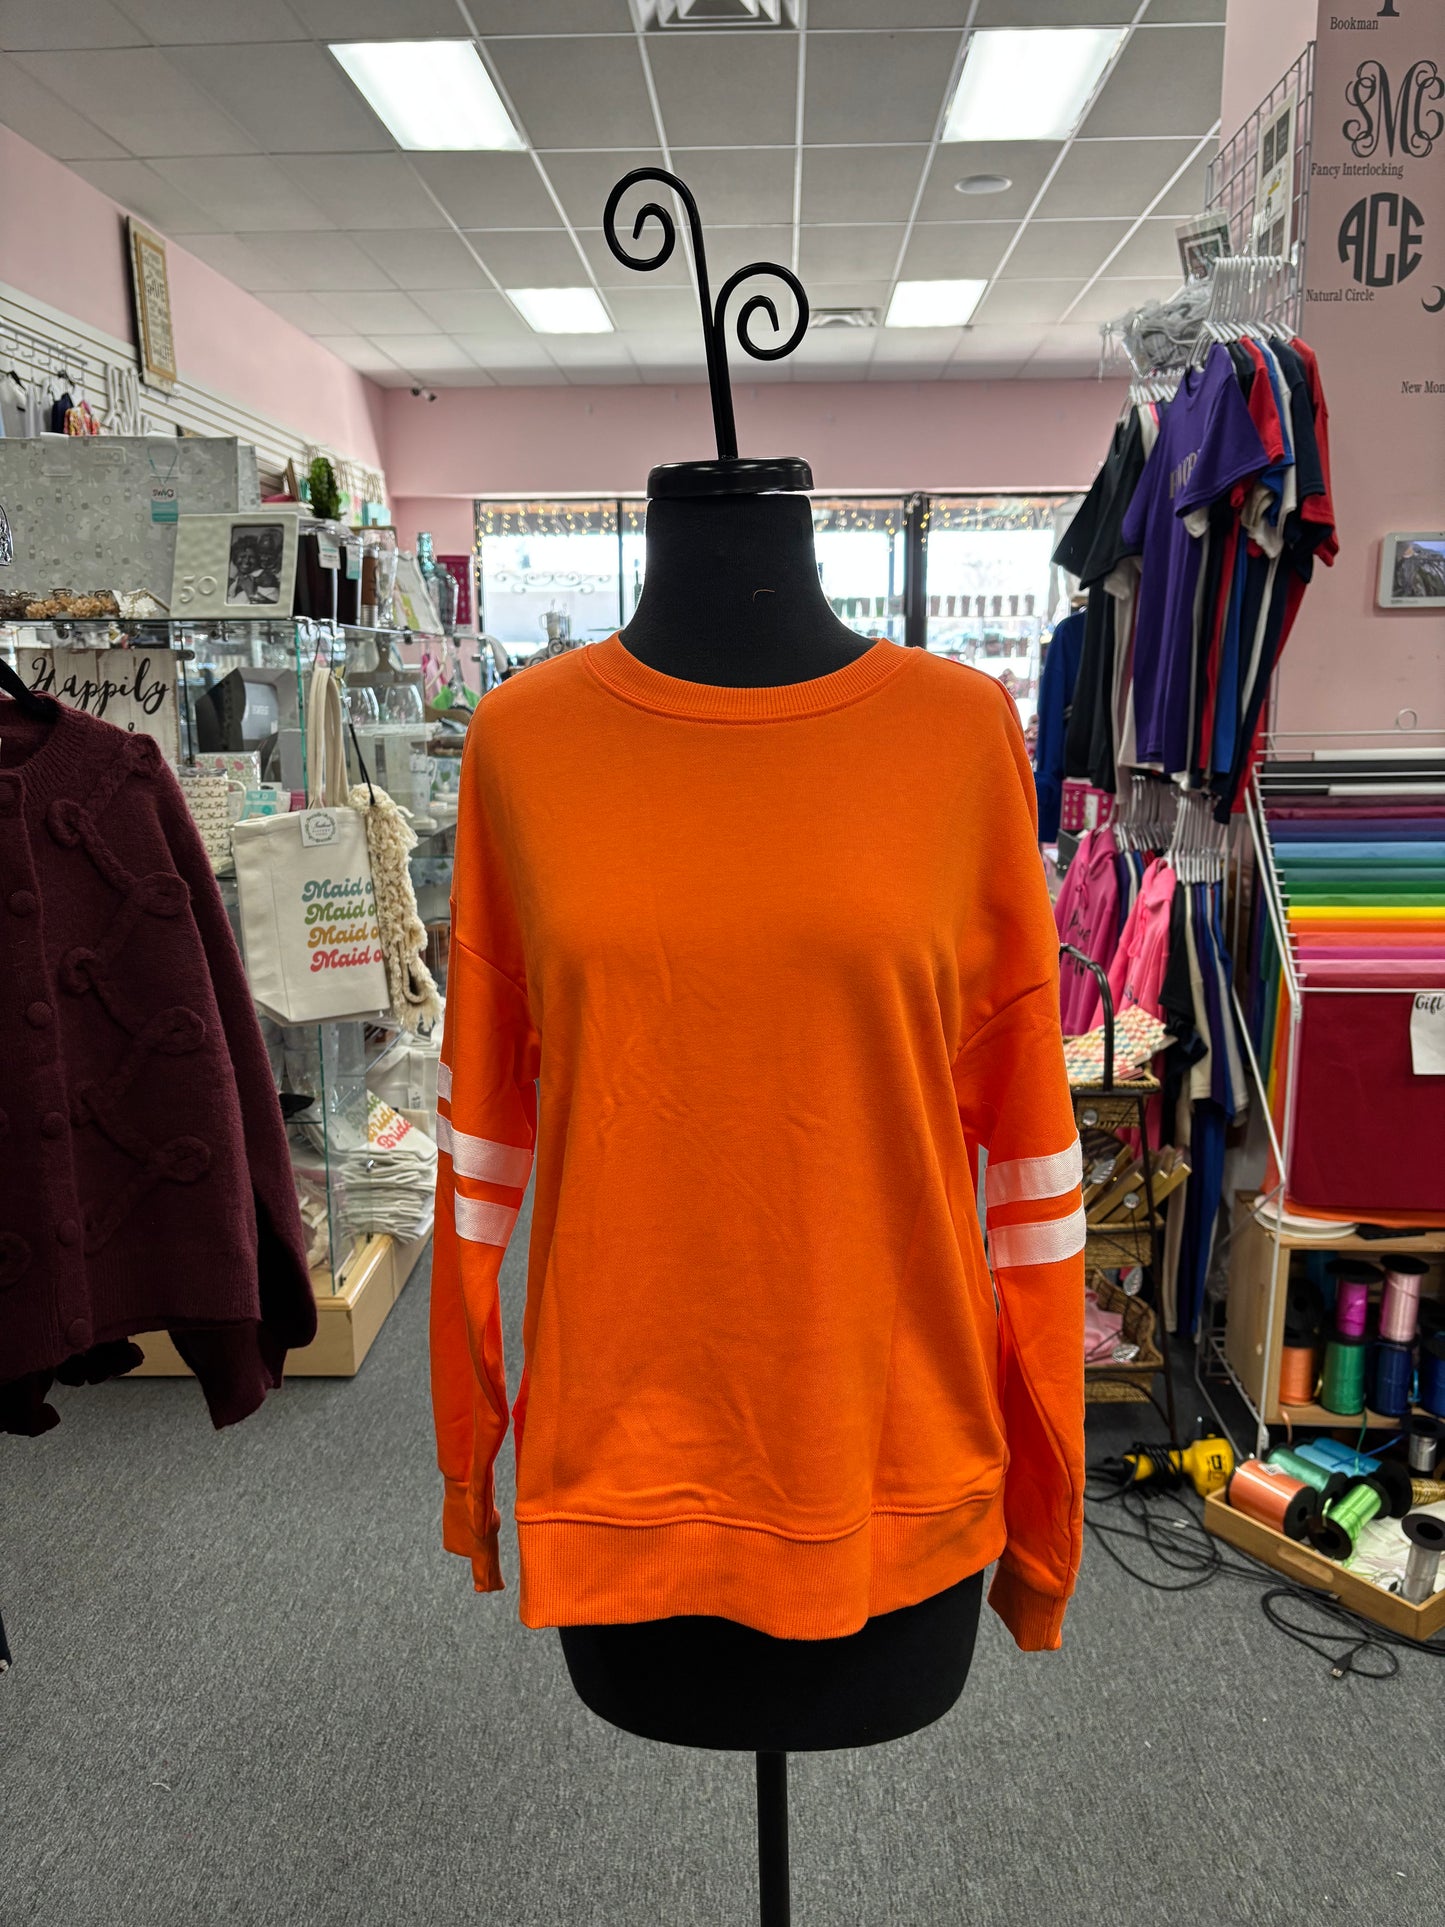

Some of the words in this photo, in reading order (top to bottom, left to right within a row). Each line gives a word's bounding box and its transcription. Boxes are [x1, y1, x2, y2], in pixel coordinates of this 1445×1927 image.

[1329, 16, 1379, 30] Bookman
[1310, 162, 1341, 179] Fancy
[1342, 162, 1404, 180] Interlocking
[1337, 192, 1425, 288] ACE
[1305, 288, 1342, 302] Natural
[1345, 288, 1375, 301] Circle
[1401, 380, 1422, 394] New
[179, 575, 217, 604] 50
[29, 656, 170, 719] Happily
[302, 876, 364, 902] Maid
[304, 899, 367, 925] Maid
[307, 922, 370, 949] Maid
[310, 945, 372, 973] Maid
[1415, 994, 1442, 1015] Gift
